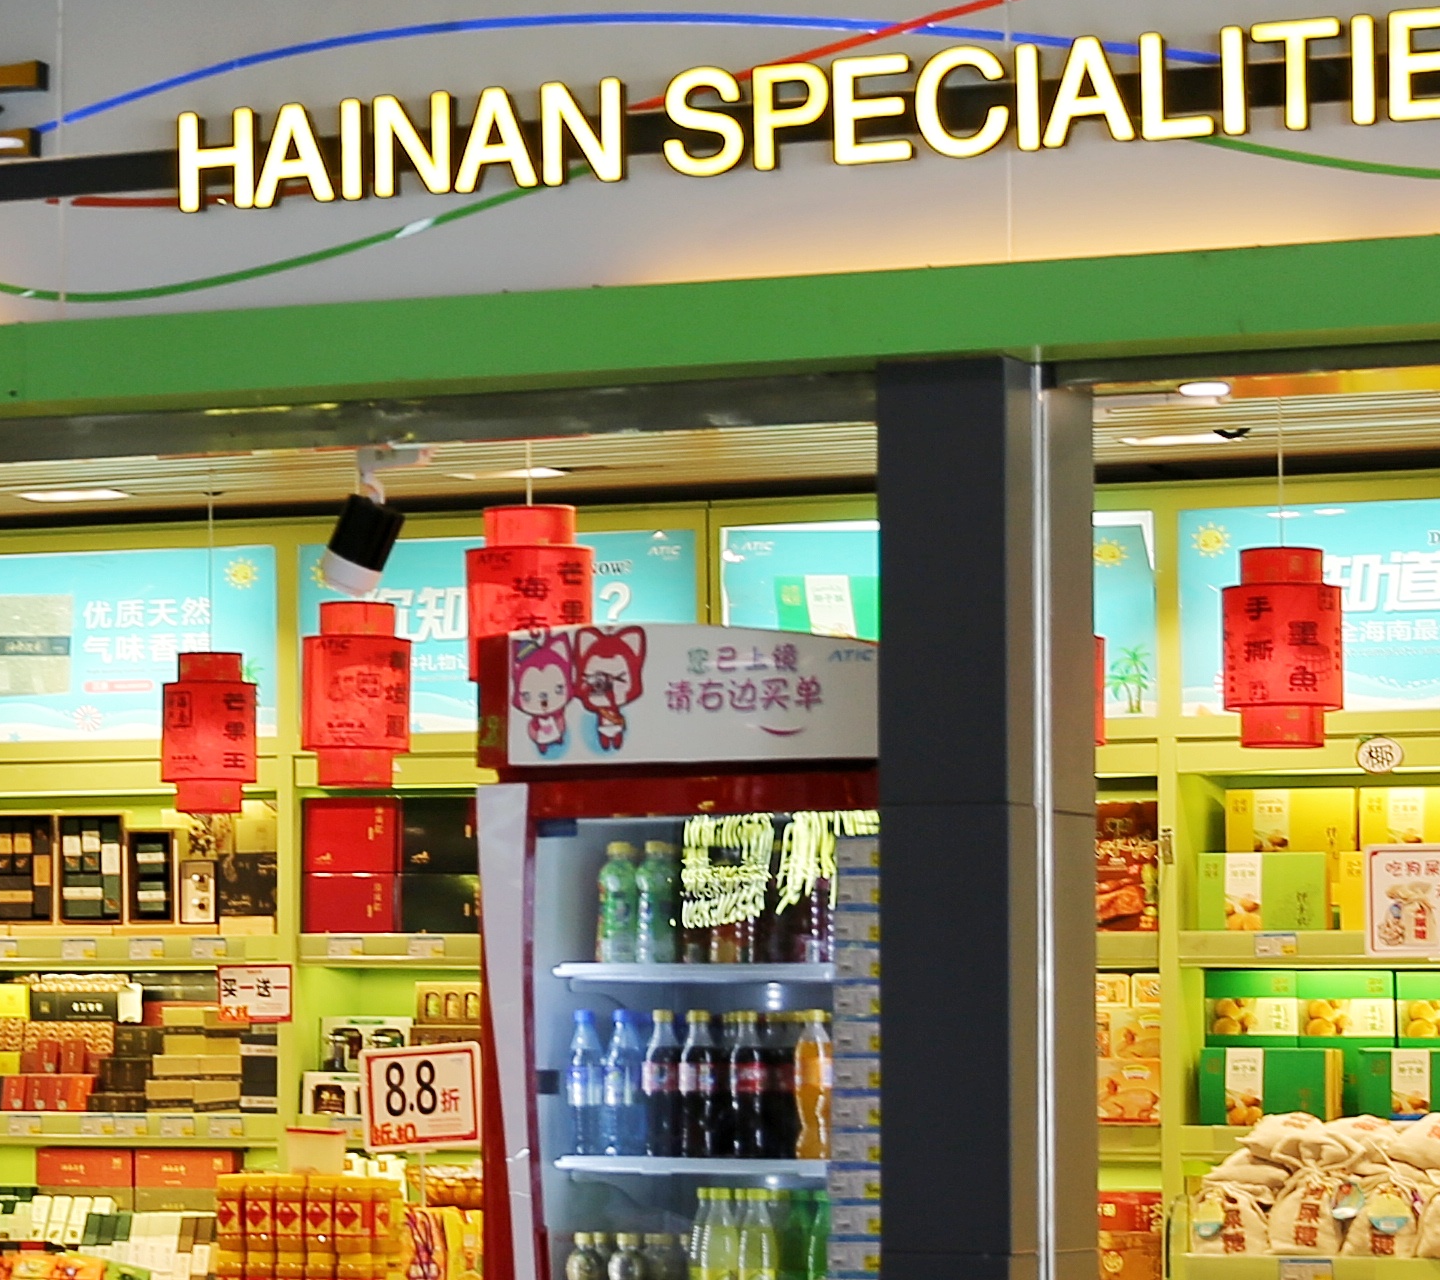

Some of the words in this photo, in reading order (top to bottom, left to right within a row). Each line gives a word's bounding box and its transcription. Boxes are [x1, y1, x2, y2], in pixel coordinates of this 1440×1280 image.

[176, 76, 625, 214] HAINAN
[84, 597, 211, 630] 优质天然
[665, 676, 823, 713] 请右边买单
[222, 692, 247, 770] 芒果王
[221, 977, 289, 998] 买一送一
[385, 1059, 461, 1117] 8.8折
